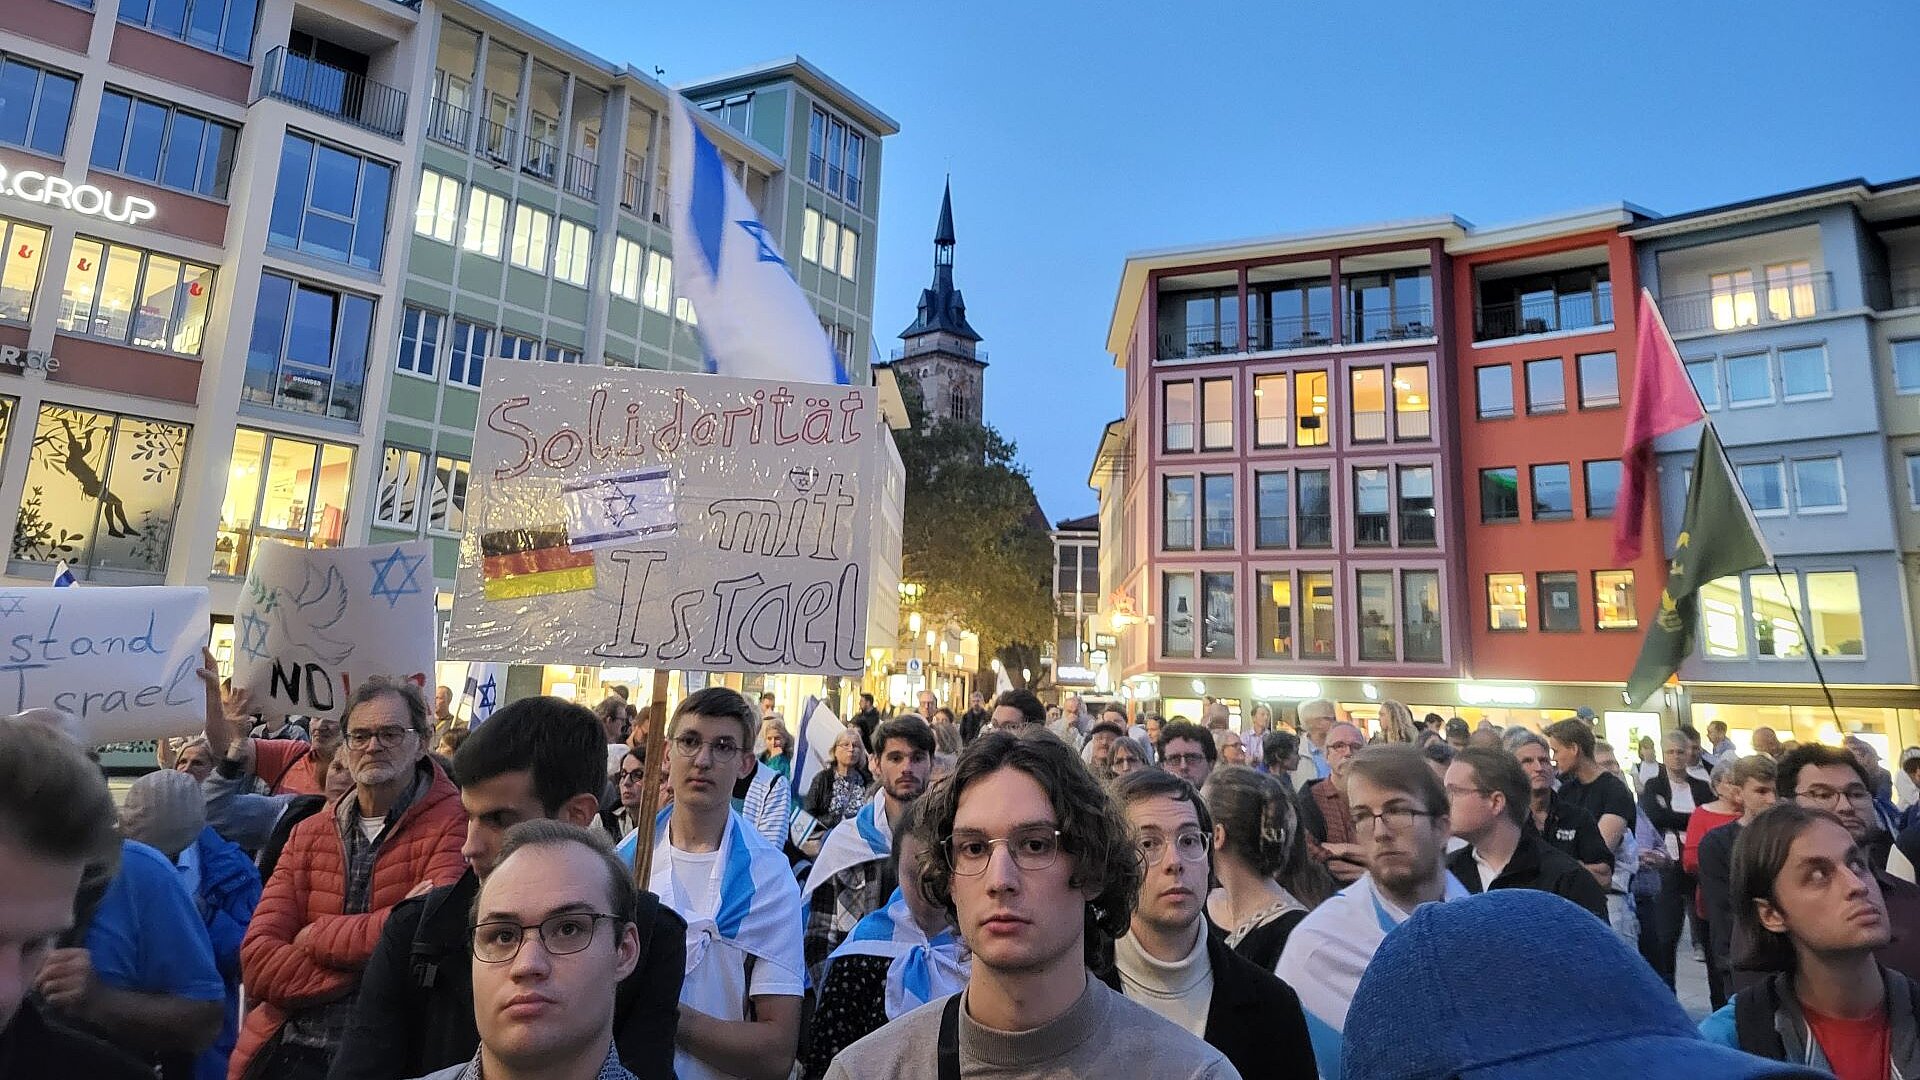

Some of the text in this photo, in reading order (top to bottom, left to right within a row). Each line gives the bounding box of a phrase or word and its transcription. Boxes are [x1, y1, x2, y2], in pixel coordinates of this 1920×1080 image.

[488, 388, 864, 481] Solidarität
[709, 466, 854, 560] mit
[9, 604, 167, 662] stand
[592, 550, 864, 671] Israel
